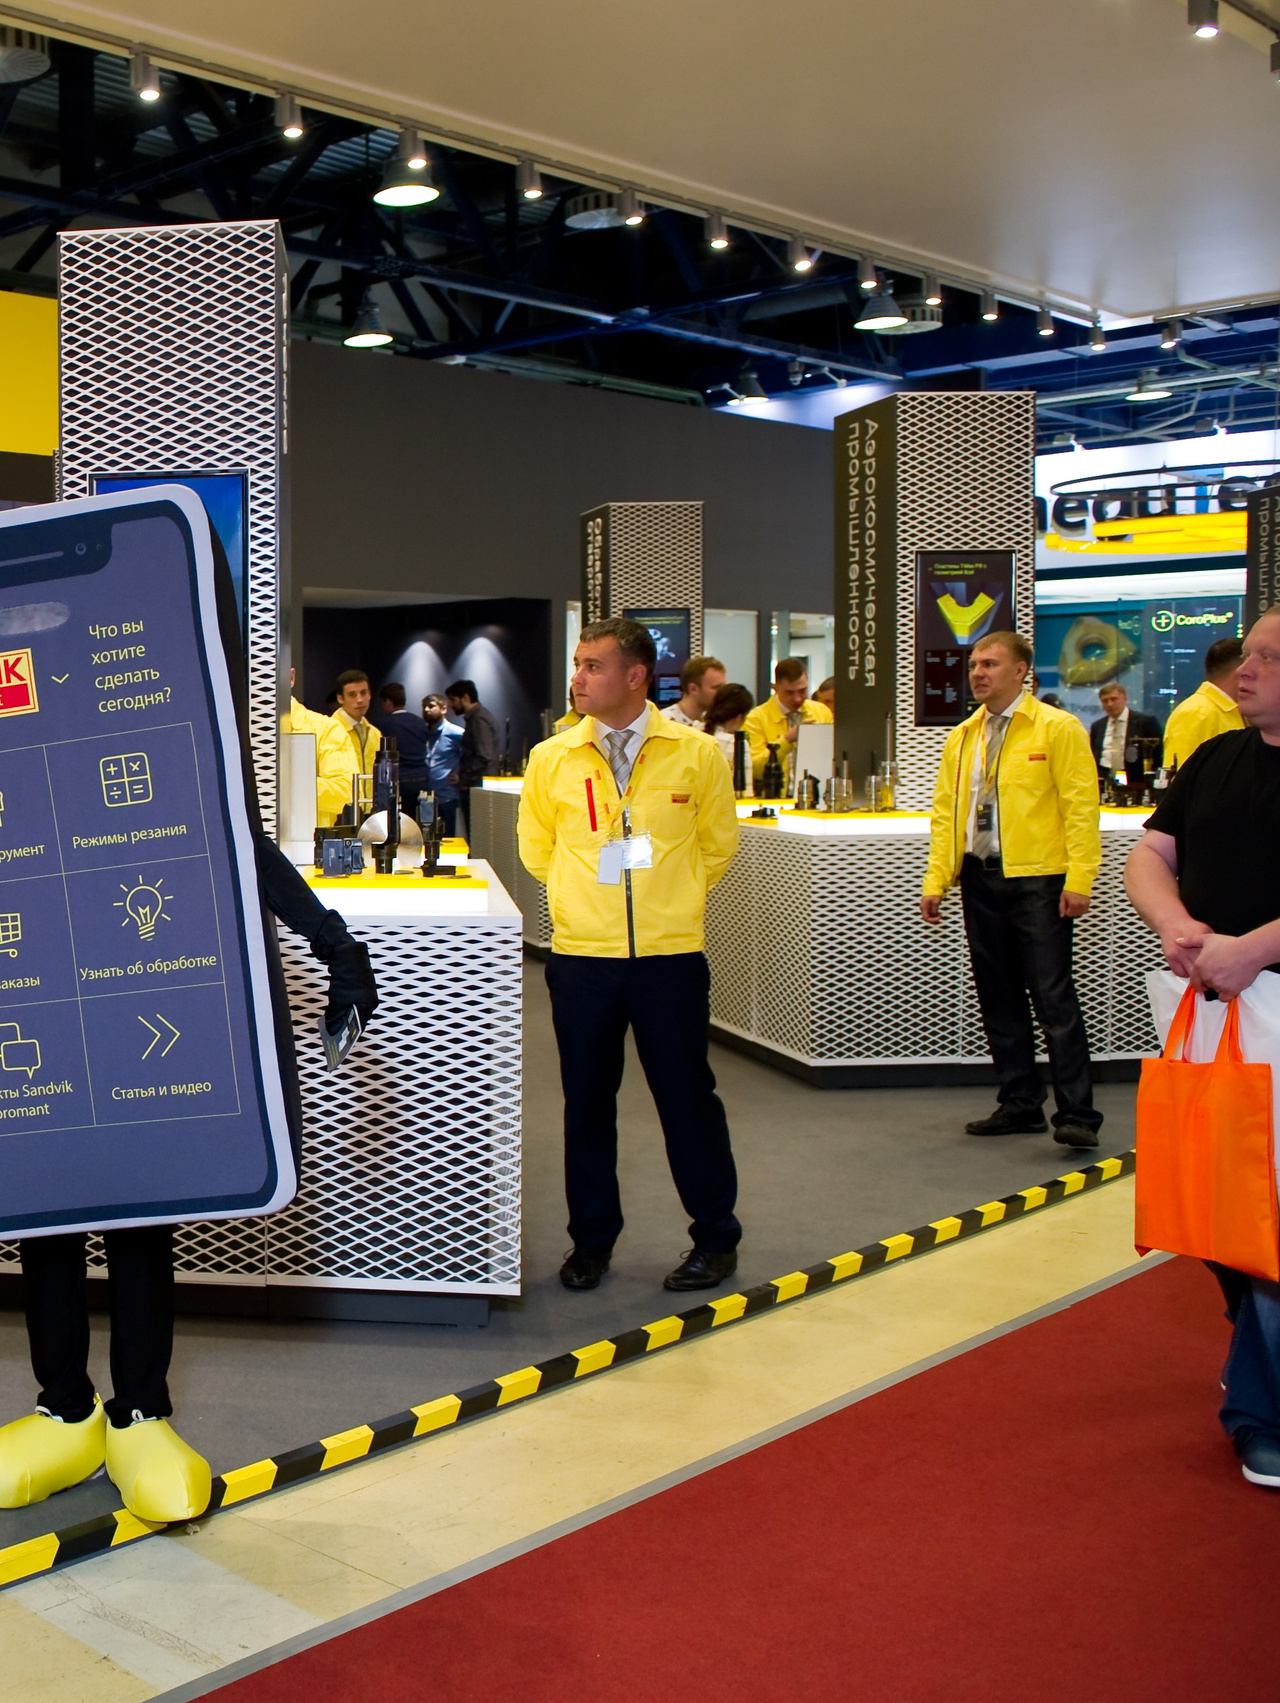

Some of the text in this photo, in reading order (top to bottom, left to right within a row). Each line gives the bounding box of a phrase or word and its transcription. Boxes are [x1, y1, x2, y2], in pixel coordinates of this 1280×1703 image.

[846, 422, 860, 681] промышленность
[862, 418, 879, 687] Аэрокосмическая
[88, 620, 144, 641] Что вы
[91, 643, 146, 666] хотите
[94, 667, 161, 690] сделать
[98, 687, 172, 714] сегодня?
[72, 824, 188, 849] Режимы резания
[80, 955, 218, 981] Узнать об обработке
[22, 1080, 74, 1098] Sandvik
[111, 1081, 213, 1100] Статья и видео
